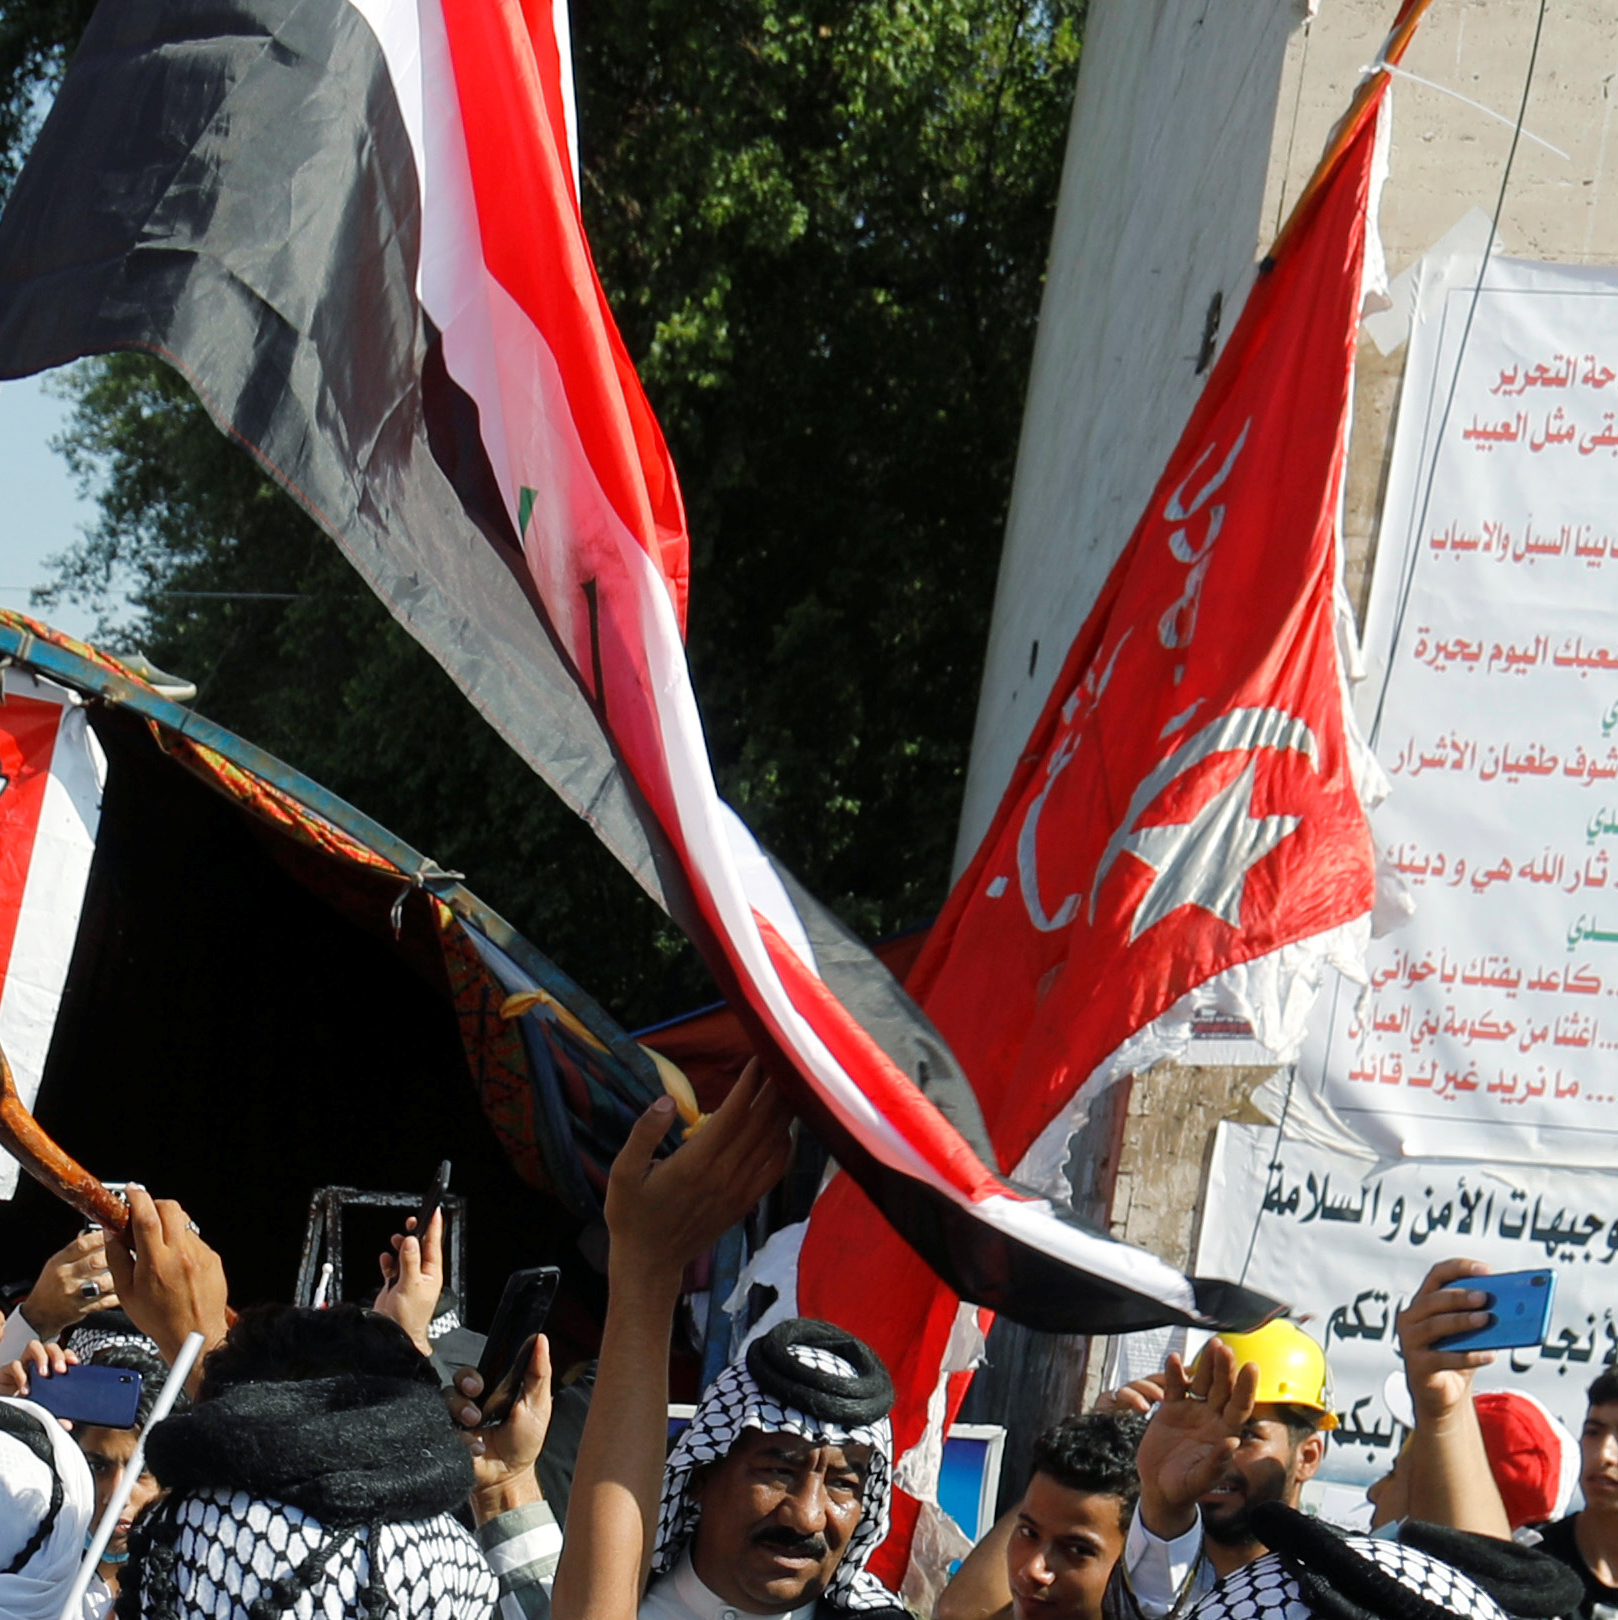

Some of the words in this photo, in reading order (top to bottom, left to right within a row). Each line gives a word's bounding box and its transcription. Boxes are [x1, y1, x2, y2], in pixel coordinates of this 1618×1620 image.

[1487, 354, 1579, 396] التحرير
[1462, 409, 1528, 452] العبيد
[1529, 405, 1576, 452] مثل
[1429, 517, 1511, 562] والاسباب
[1413, 626, 1484, 673] بحيرة
[1487, 633, 1550, 675] اليوم
[1552, 634, 1617, 679] عبك
[1388, 730, 1478, 777] الأشرار
[1478, 742, 1560, 784] طغيان
[1385, 844, 1447, 887] دينك
[1469, 856, 1514, 895] هي
[1517, 846, 1566, 885] الله
[1526, 962, 1603, 996] كاعد
[1409, 1009, 1442, 1054] بني
[1442, 1005, 1517, 1047] حكومة
[1518, 1016, 1551, 1053] من
[1348, 1051, 1405, 1086] قائد
[1407, 1060, 1481, 1102] غيرك
[1485, 1065, 1549, 1105] نريد
[1554, 1069, 1582, 1099] ما
[1263, 1160, 1383, 1234] السلامة
[1408, 1176, 1496, 1247] الأمن
[1498, 1190, 1617, 1265] وجيهات
